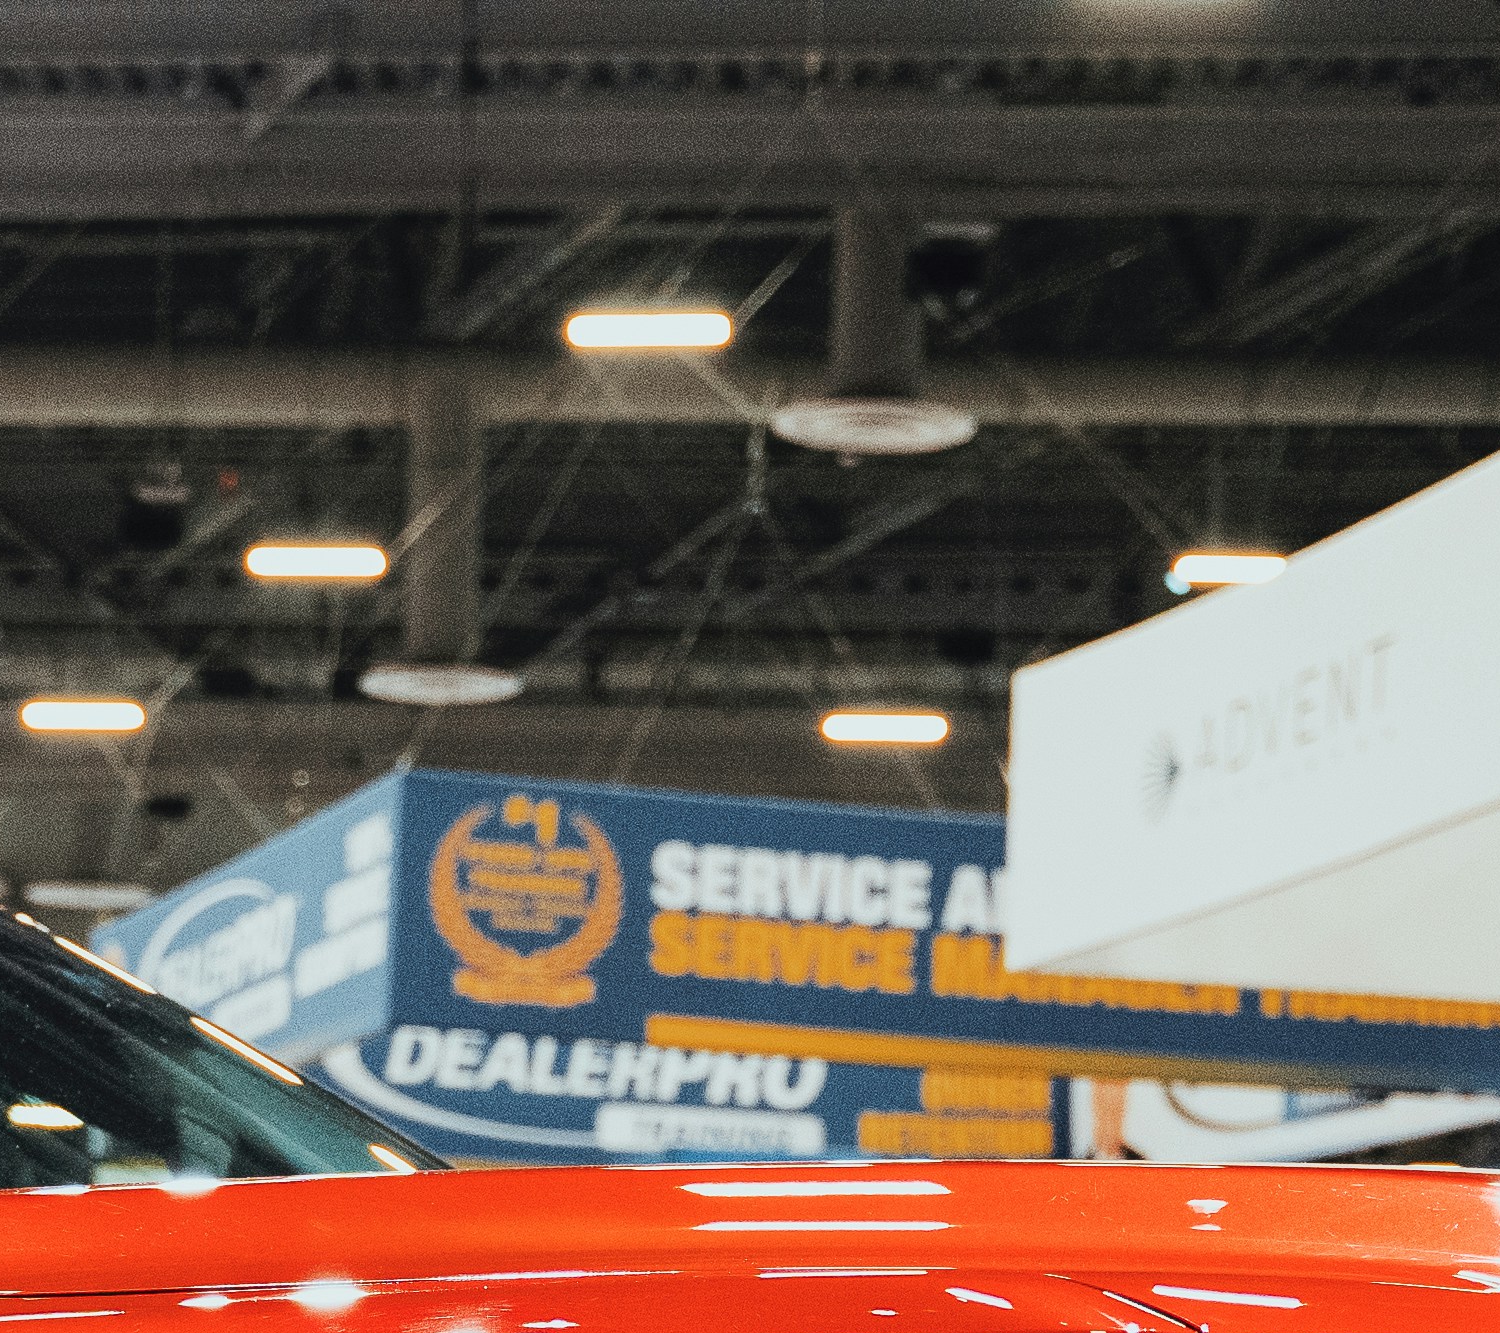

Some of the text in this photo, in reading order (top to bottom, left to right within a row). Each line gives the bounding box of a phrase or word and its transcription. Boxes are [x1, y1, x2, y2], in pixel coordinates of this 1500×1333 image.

[1194, 633, 1396, 776] ADVENT
[650, 840, 934, 930] SERVICE
[648, 908, 917, 994] SERVICE
[384, 1024, 829, 1109] DEALERPRO
